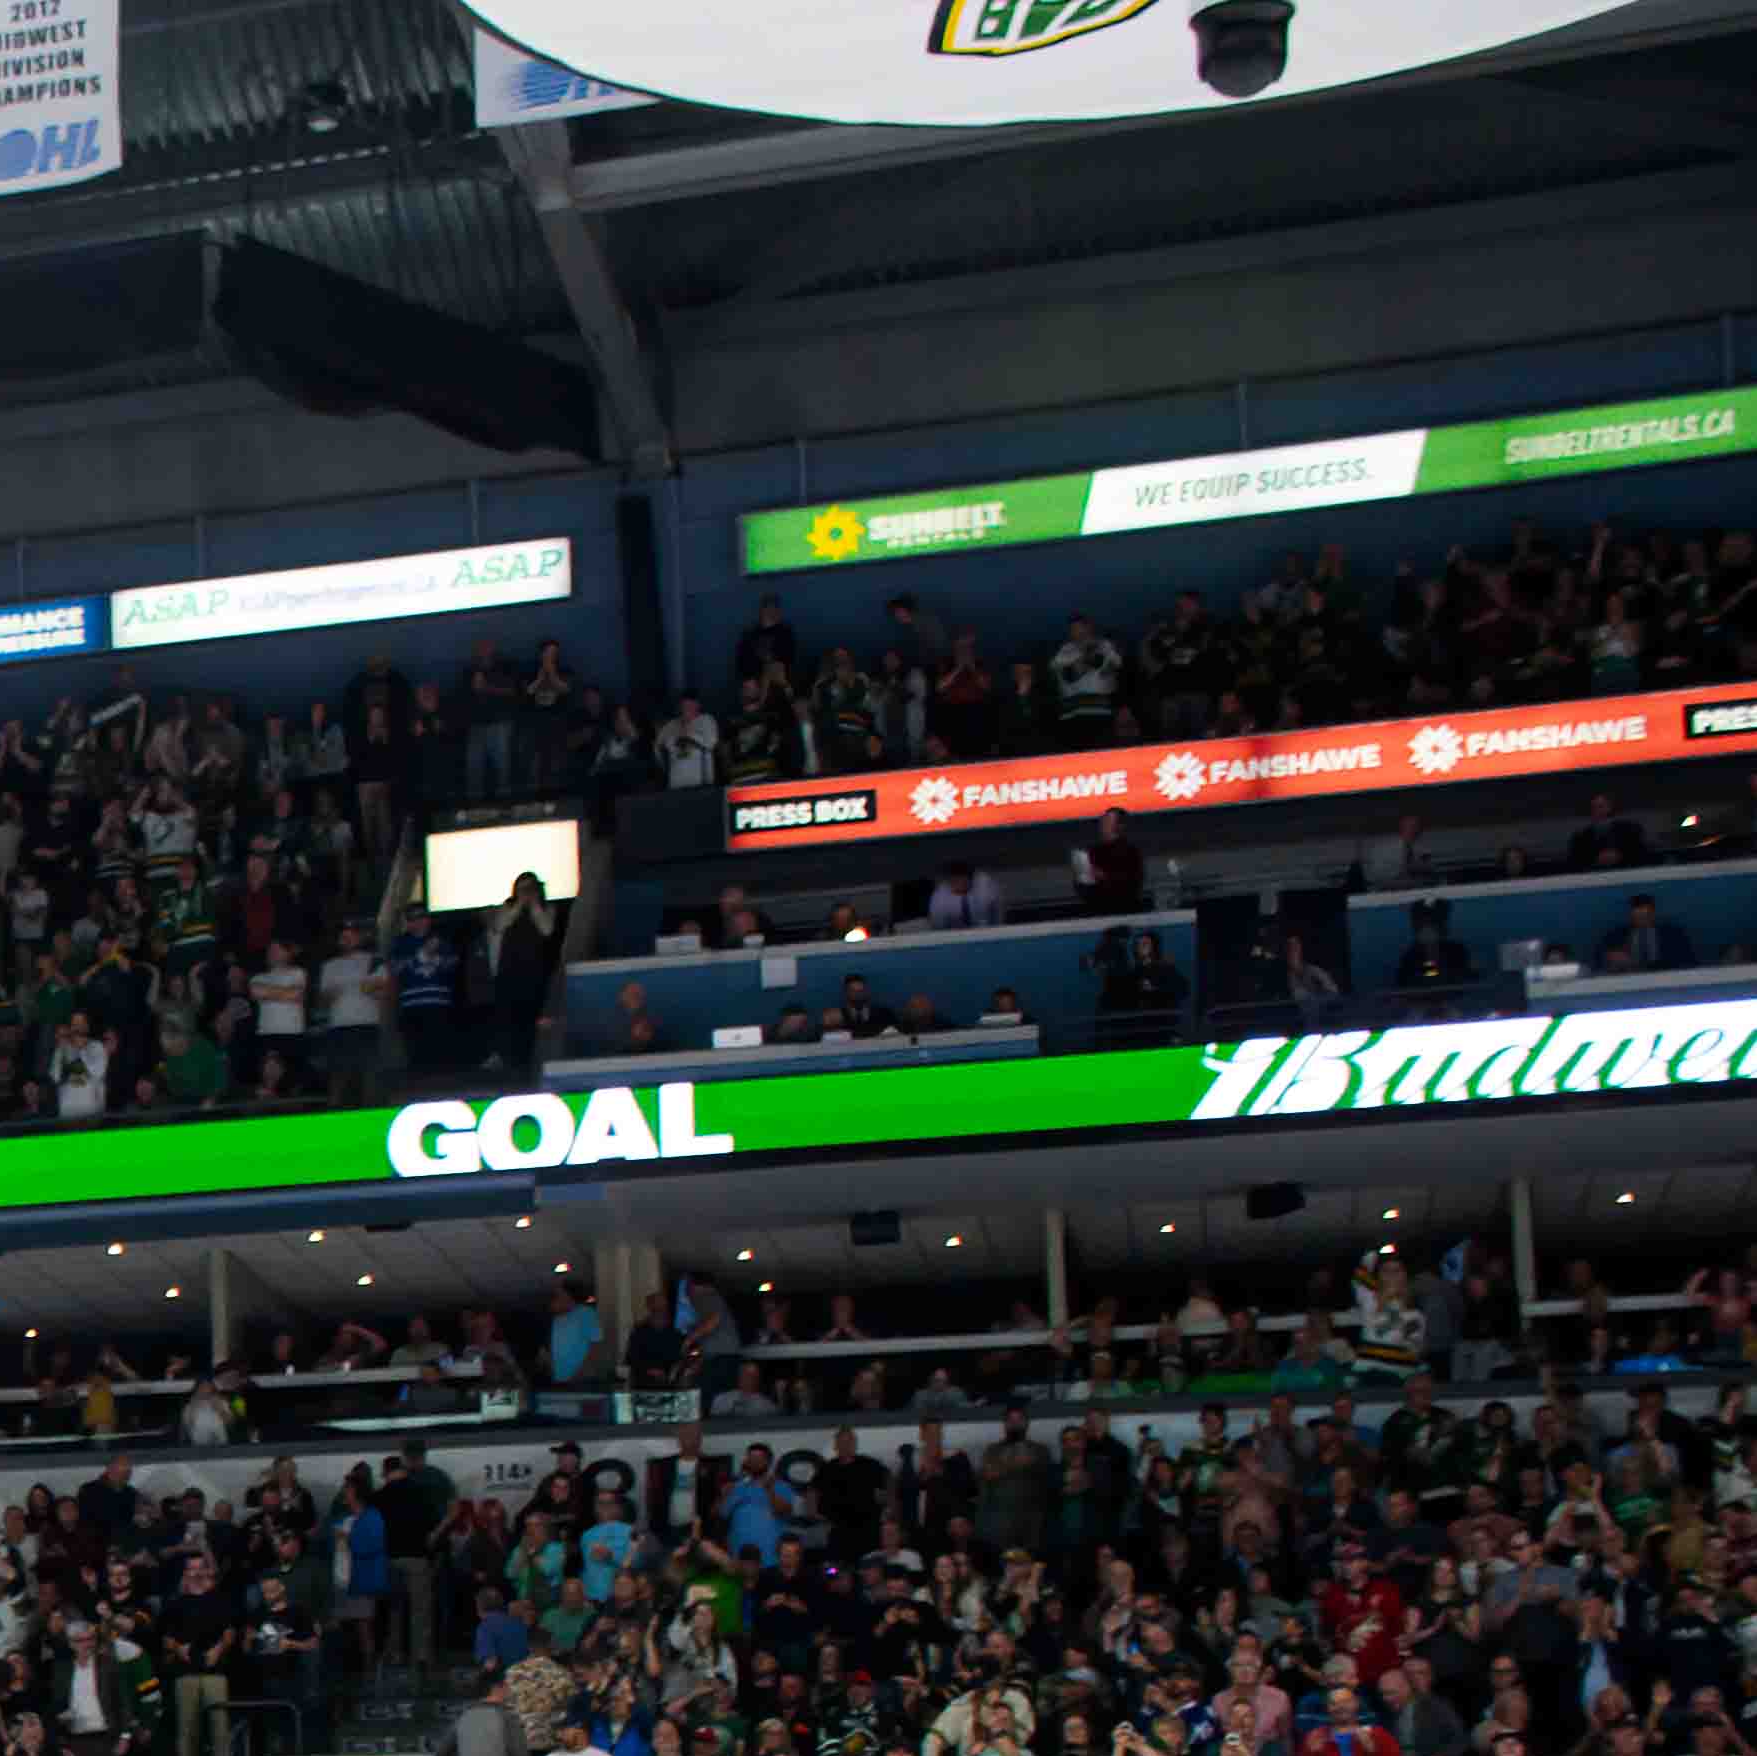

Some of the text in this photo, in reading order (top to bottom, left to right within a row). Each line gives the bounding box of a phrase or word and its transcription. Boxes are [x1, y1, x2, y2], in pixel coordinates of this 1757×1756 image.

[1135, 482, 1171, 508] WE
[1180, 474, 1248, 502] EQUIP
[451, 549, 564, 588] ASAP
[122, 589, 230, 626] ASAP
[1467, 716, 1647, 757] FANSHAWE
[1208, 744, 1382, 784] FANSHAWE
[962, 770, 1127, 808] FANSHAWE
[735, 796, 869, 830] PRESS BOX
[387, 1082, 734, 1178] GOAL
